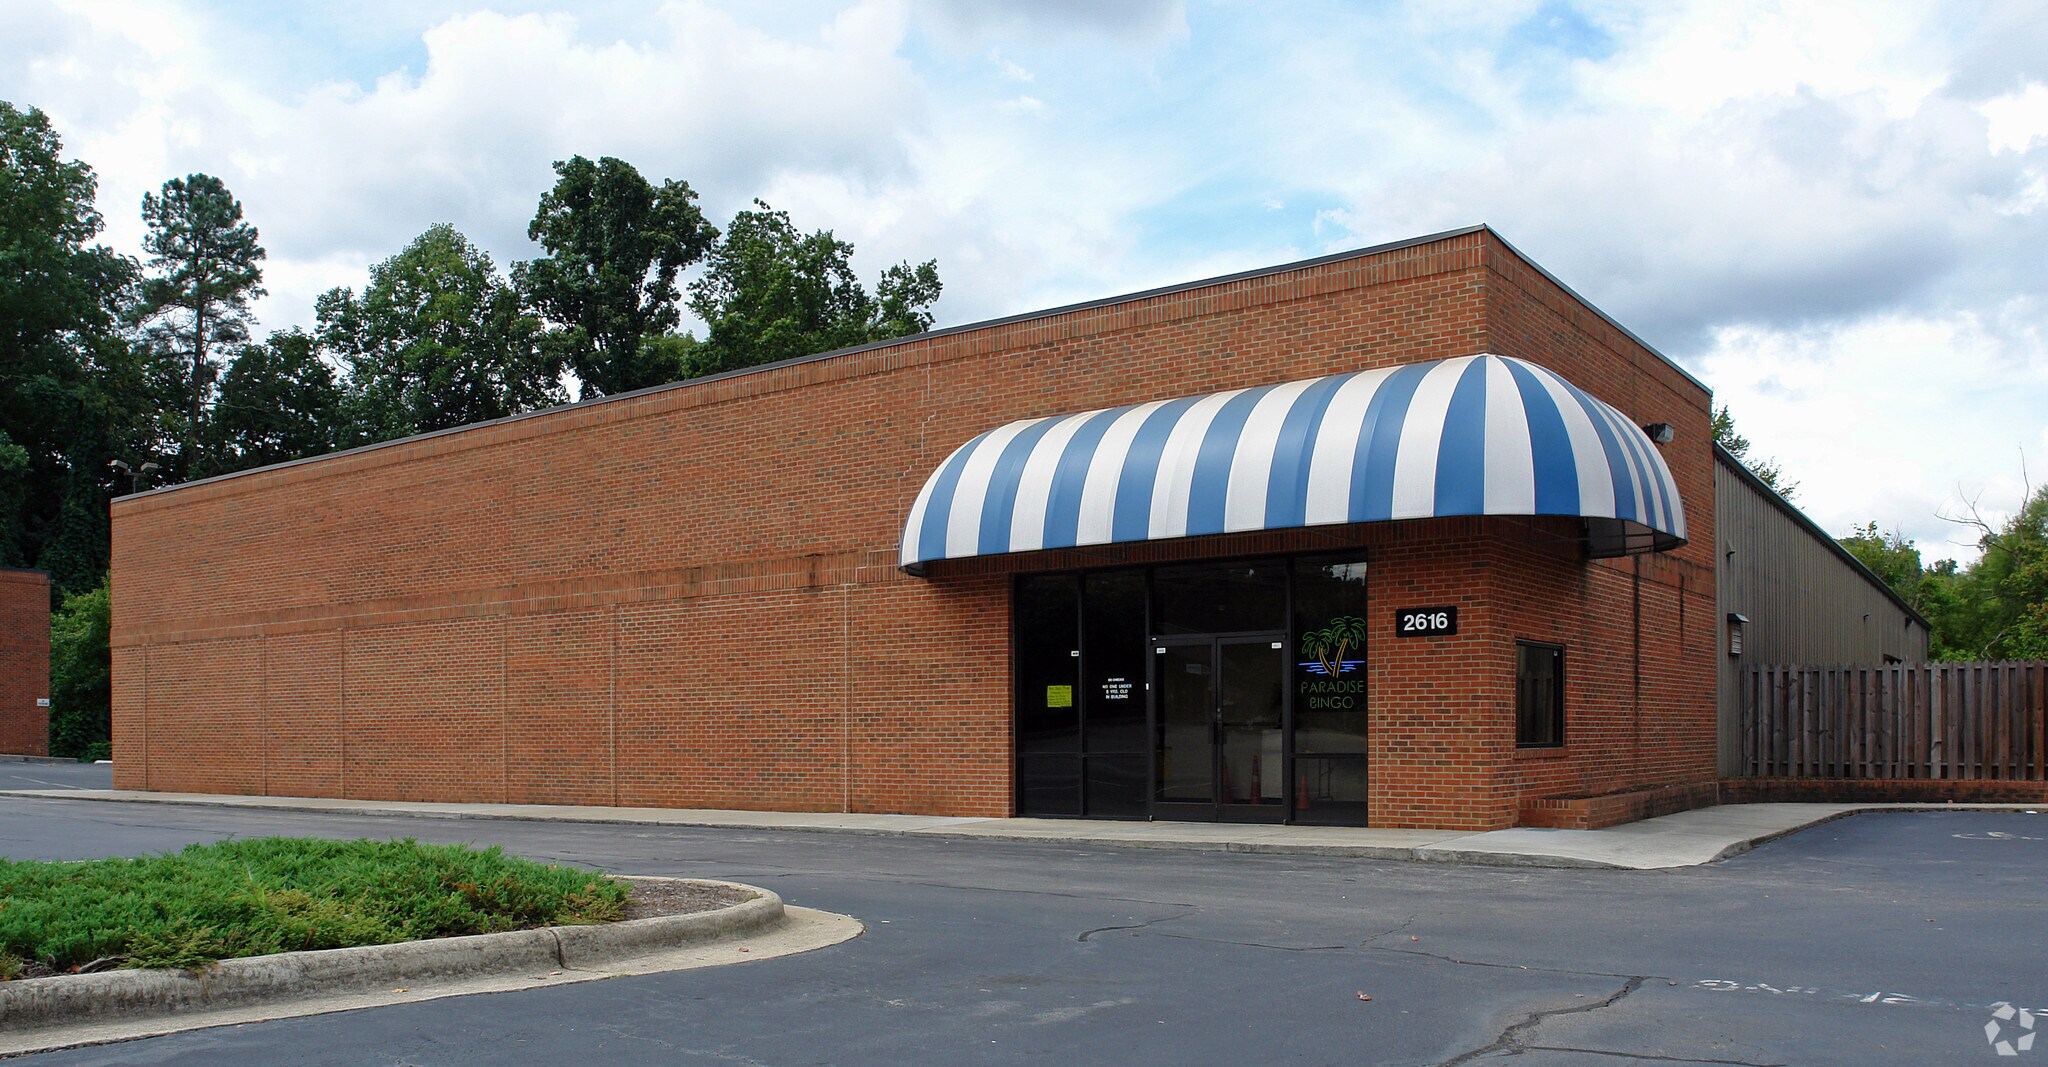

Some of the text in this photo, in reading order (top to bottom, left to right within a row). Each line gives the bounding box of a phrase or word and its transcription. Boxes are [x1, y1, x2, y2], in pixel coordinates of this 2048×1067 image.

[1403, 612, 1448, 631] 2616
[1300, 680, 1365, 694] PARADISE
[1310, 696, 1354, 709] BINGO
